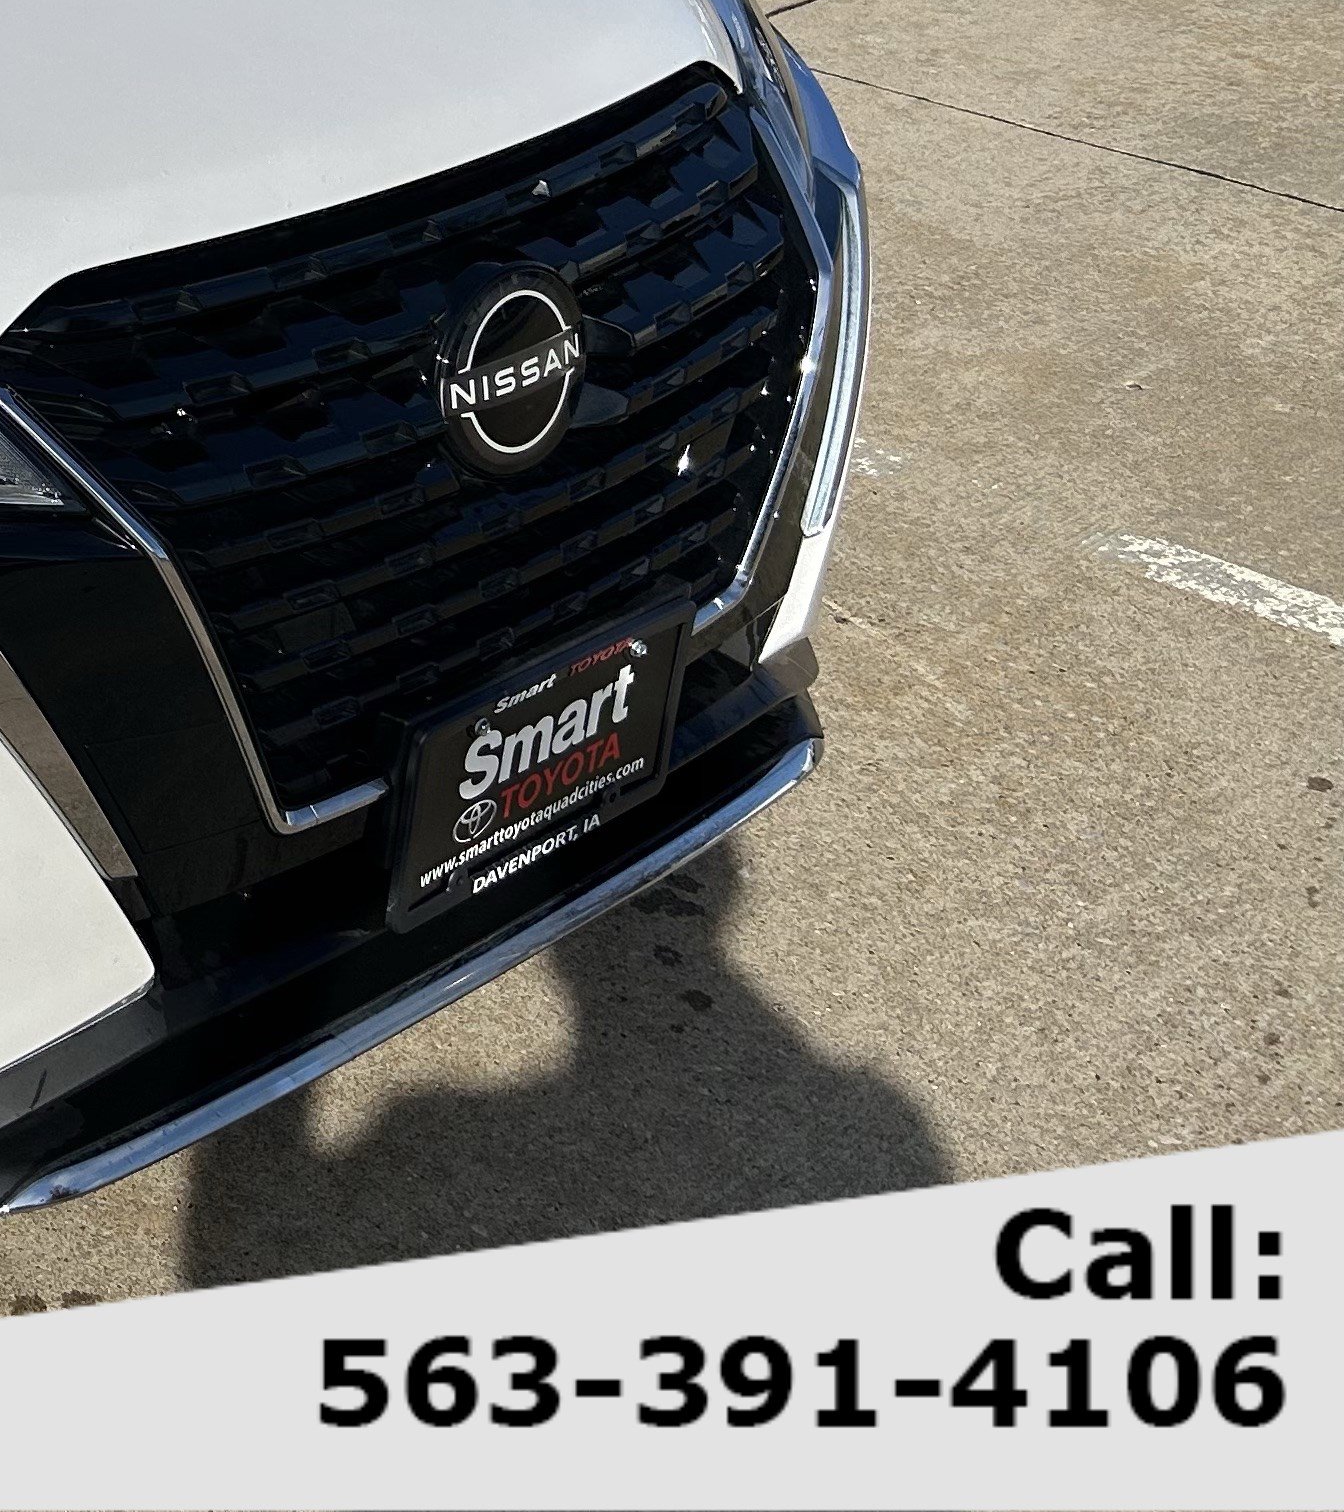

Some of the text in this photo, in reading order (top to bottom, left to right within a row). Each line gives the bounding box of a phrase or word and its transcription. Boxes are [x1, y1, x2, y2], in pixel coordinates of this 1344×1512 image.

[450, 332, 580, 409] NISSAN
[494, 637, 634, 714] Smart TOYOTA
[459, 664, 635, 800] Smart
[499, 733, 621, 819] TOYOTA
[420, 755, 645, 888] www.smarttoyotaquadcities.com
[472, 813, 602, 894] DAVENPORT, IA
